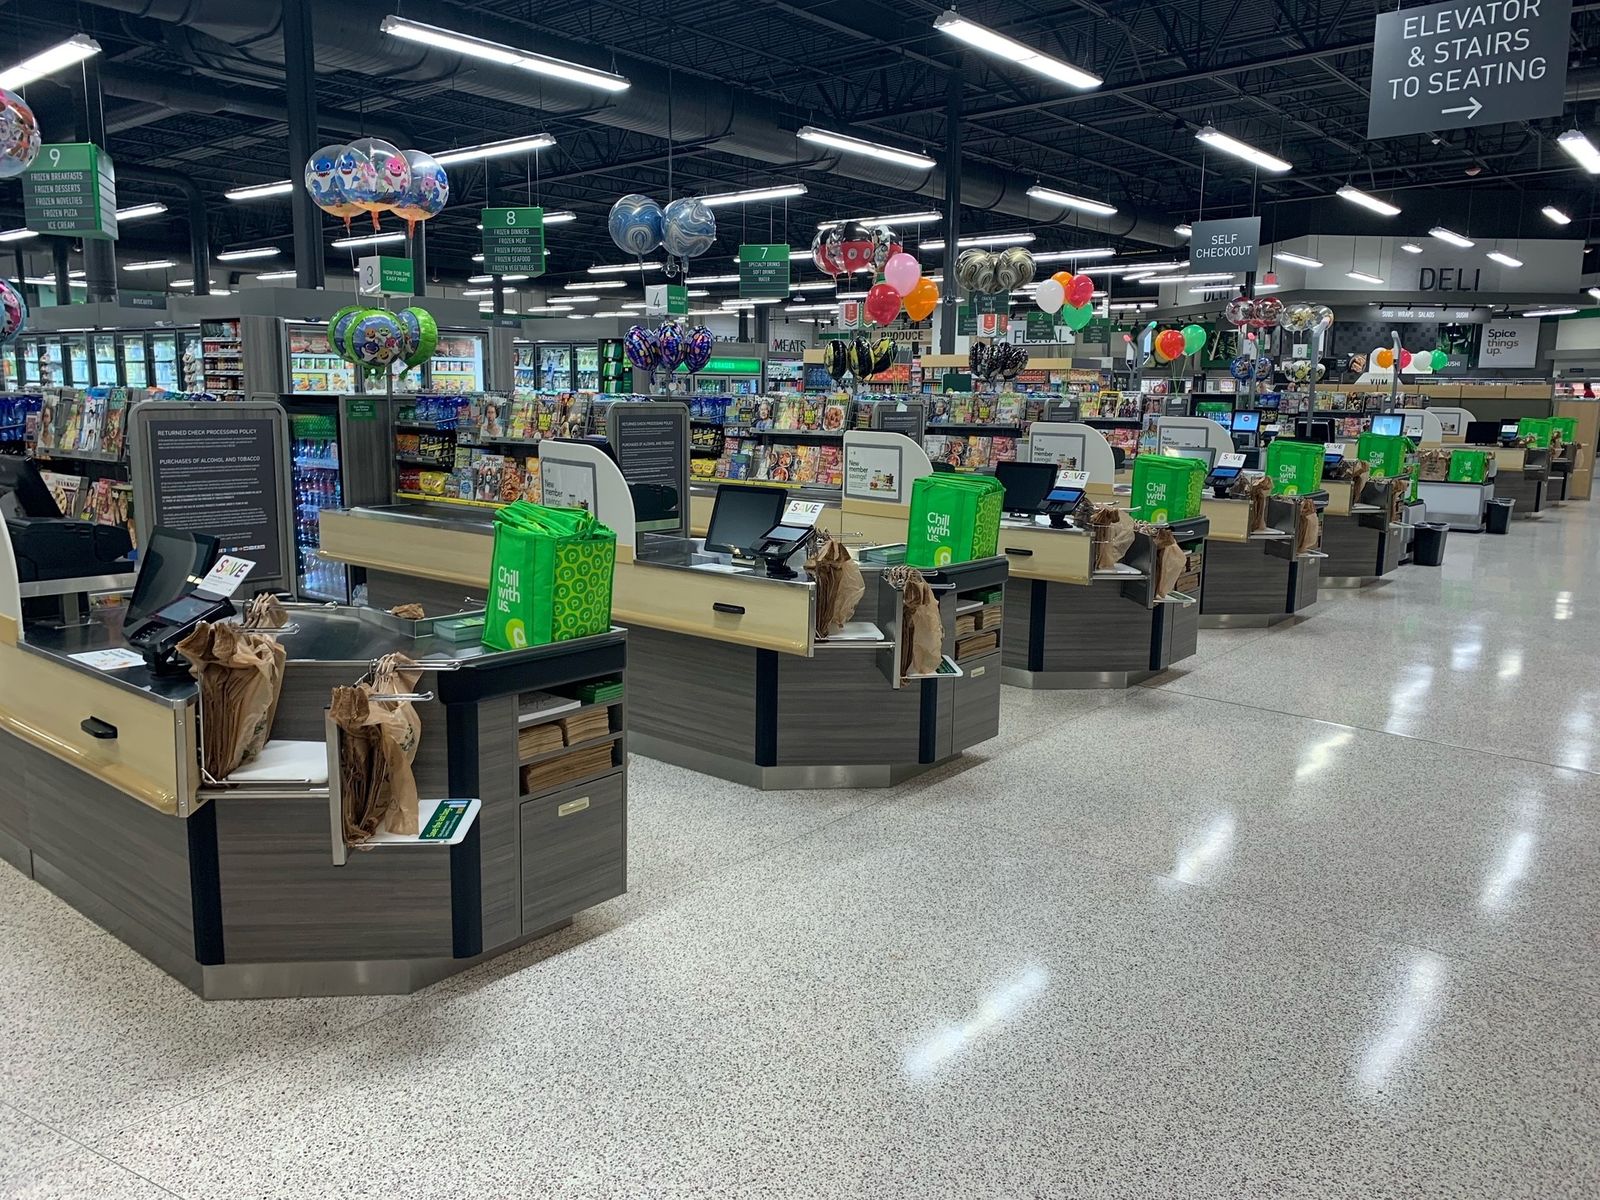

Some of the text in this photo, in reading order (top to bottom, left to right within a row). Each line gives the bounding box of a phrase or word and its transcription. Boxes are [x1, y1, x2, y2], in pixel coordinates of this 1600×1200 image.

[1403, 0, 1540, 39] ELEVATOR
[1407, 28, 1531, 67] & STAIRS
[1388, 57, 1546, 100] TO SEATING
[49, 148, 61, 168] 9
[30, 171, 83, 181] FROZEN BREAKFASTS
[34, 184, 81, 193] FROZEN DESSERTS
[35, 196, 83, 206] FROZEN NOVELTIES
[43, 208, 78, 217] FROZEN PIZZA
[506, 210, 516, 226] 8
[47, 221, 76, 230] ICE CREAM
[1211, 233, 1238, 245] SELF
[760, 247, 769, 259] 7
[1195, 245, 1253, 258] CHECKOUT
[366, 265, 374, 286] 3
[1419, 267, 1481, 291] DELI
[653, 291, 661, 308] 4
[1038, 312, 1044, 320] 2
[1381, 310, 1394, 318] SUBS
[1397, 310, 1414, 318] WRAPS
[1488, 328, 1517, 340] Spice
[773, 338, 807, 352] MEATS
[1487, 338, 1519, 349] things
[1297, 346, 1303, 356] 8
[1486, 347, 1503, 357] up.
[1279, 464, 1297, 473] Chill
[1146, 482, 1167, 493] Chill
[1146, 491, 1166, 501] with
[927, 511, 951, 526] Chill
[927, 523, 951, 537] with
[926, 533, 942, 543] us.
[497, 565, 520, 588] Chill
[497, 585, 521, 604] with
[497, 598, 511, 613] us.
